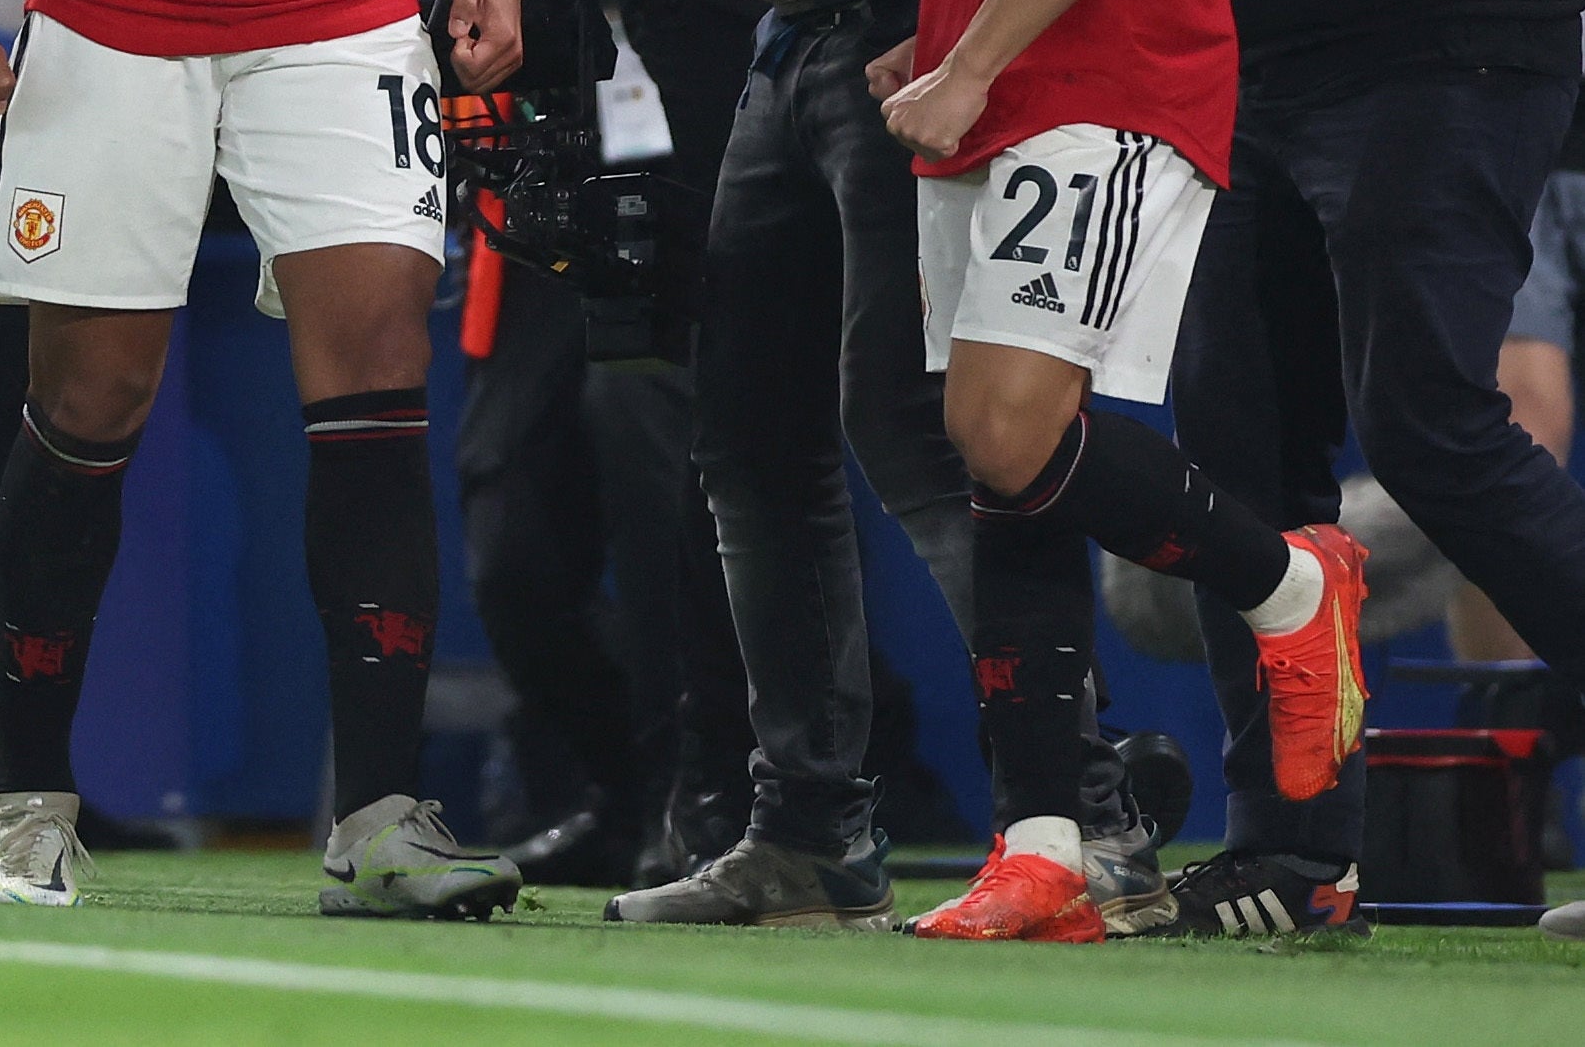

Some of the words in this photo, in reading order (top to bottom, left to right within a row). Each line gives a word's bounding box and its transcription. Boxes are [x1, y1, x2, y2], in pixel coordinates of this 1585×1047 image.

[377, 74, 445, 179] 18
[989, 165, 1099, 272] 21
[1011, 291, 1066, 314] adidas
